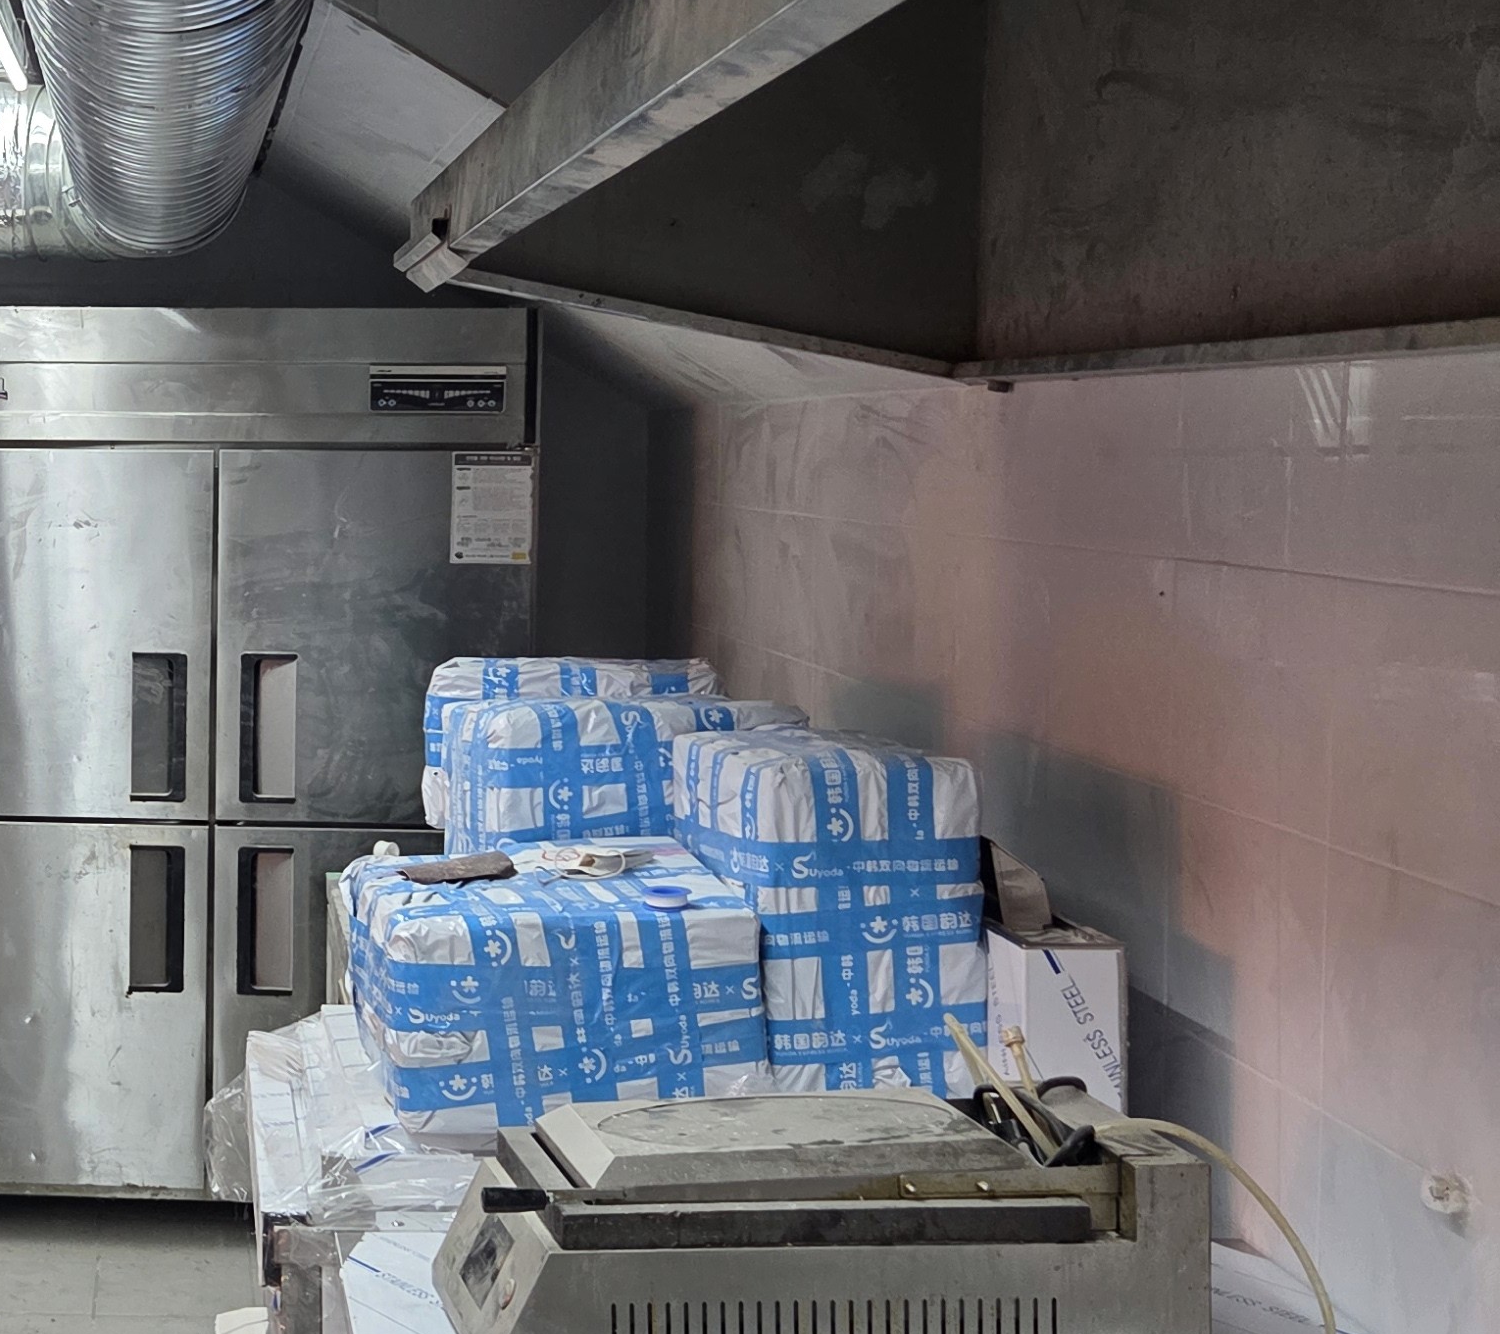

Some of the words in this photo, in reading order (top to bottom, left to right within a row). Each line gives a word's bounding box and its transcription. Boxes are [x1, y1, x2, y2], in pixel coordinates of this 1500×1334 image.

[791, 852, 844, 879] Suyoda
[902, 912, 973, 932] 韩国韵达
[1061, 978, 1095, 1025] STEEL
[774, 1030, 847, 1050] 韩国韵达
[869, 1020, 922, 1050] Suyoda
